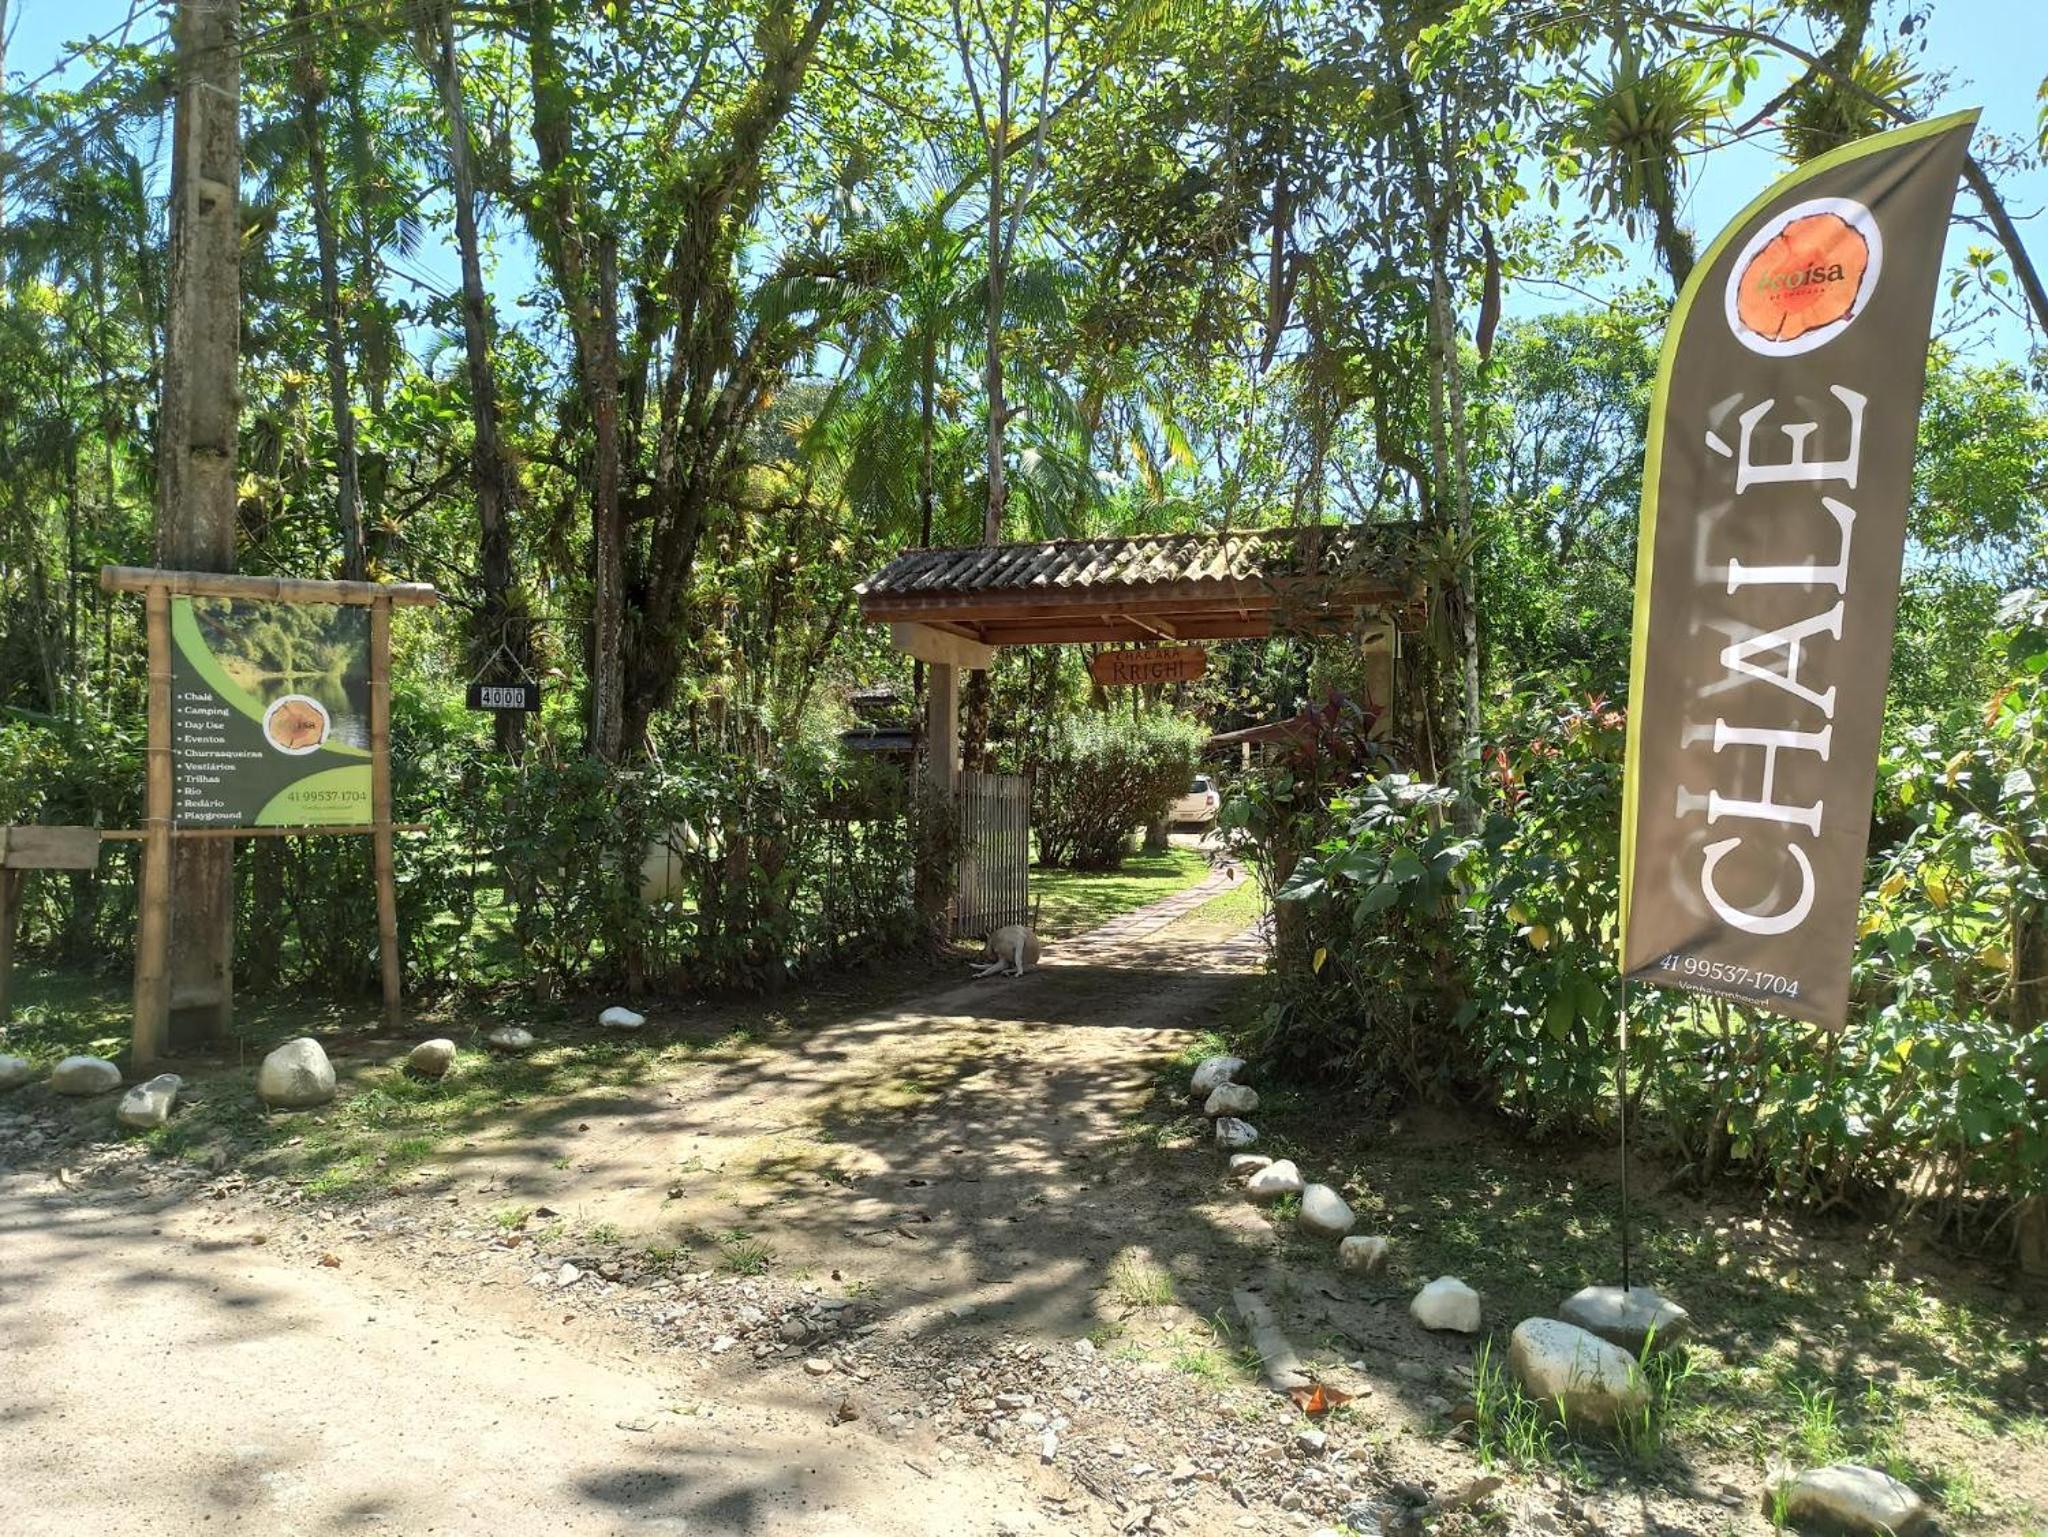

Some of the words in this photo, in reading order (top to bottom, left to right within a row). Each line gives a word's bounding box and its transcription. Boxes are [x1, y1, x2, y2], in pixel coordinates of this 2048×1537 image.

[1701, 385, 1867, 934] CHALÉ
[482, 690, 524, 705] 4000
[184, 706, 229, 716] Camping
[184, 721, 204, 730] Day
[205, 721, 225, 730] Use
[184, 735, 225, 743] Eventos
[184, 749, 263, 758] Churrasqueiras
[184, 762, 236, 771] Vestiários
[184, 775, 221, 783] Trilhas
[184, 787, 202, 795] Rio
[287, 792, 300, 801] 41
[184, 811, 242, 821] Playground
[1659, 954, 1680, 971] 41
[1684, 957, 1799, 998] 99537-1704
